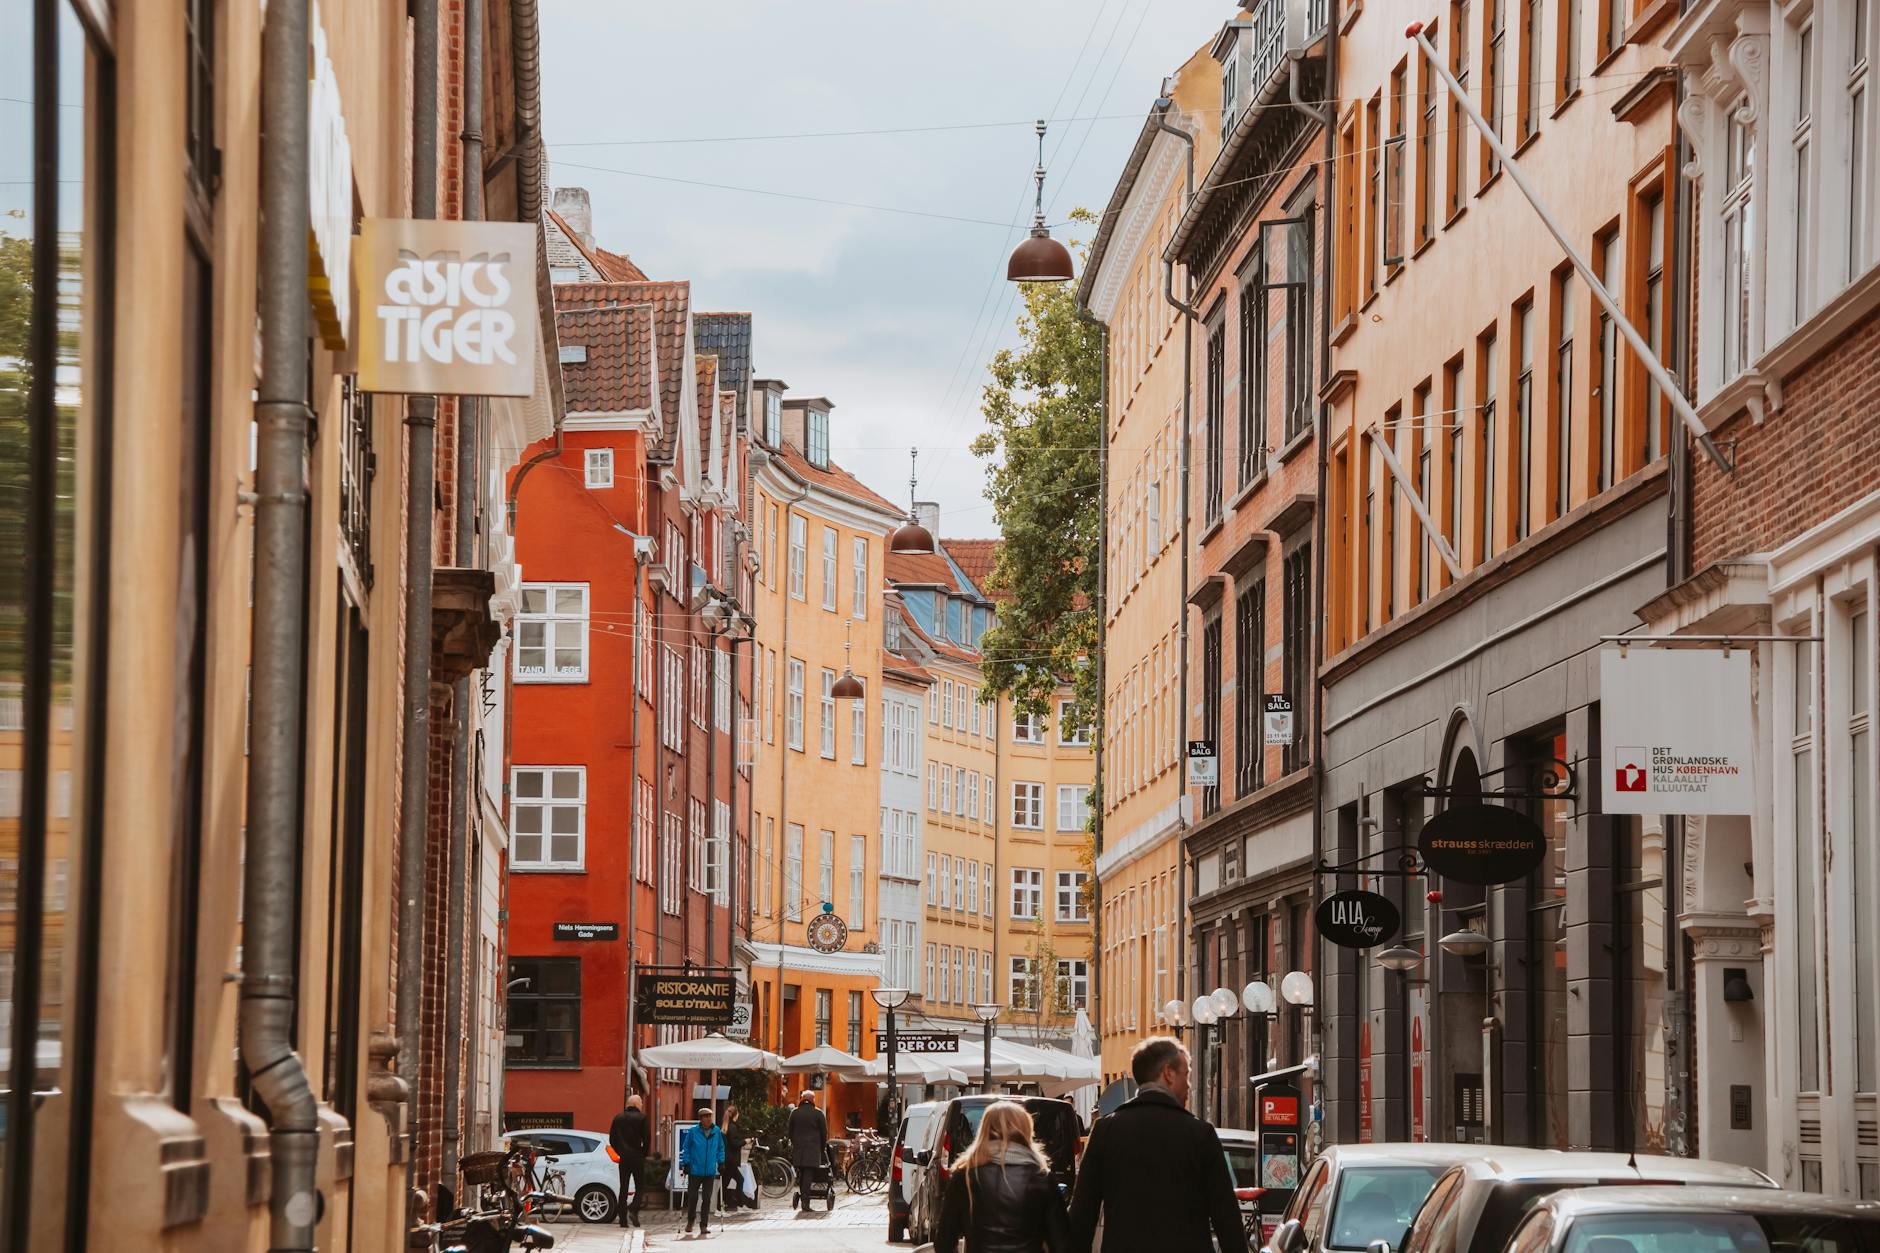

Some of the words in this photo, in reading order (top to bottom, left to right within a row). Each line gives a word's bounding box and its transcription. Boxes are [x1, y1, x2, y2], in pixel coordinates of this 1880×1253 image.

[377, 305, 517, 365] TIGER
[1267, 702, 1290, 710] SALG
[1191, 748, 1211, 756] SALG
[1652, 747, 1672, 756] DET
[1652, 757, 1728, 765] GRØNLANDSKE
[1652, 766, 1674, 774] HUS
[1676, 766, 1738, 774] KØBENHAVN
[1653, 775, 1709, 784] KALAALLIT
[1653, 784, 1708, 793] ILLUUTAAT
[1431, 839, 1477, 849] strauss
[1478, 839, 1534, 849] skrædderi
[574, 924, 614, 932] Hemmingsens
[656, 982, 729, 996] RISTORANTE
[656, 999, 684, 1009] SOLE
[684, 999, 729, 1010] D'ITALIA
[880, 1041, 925, 1051] PDER
[927, 1041, 956, 1051] OXE
[1265, 1101, 1275, 1114] P
